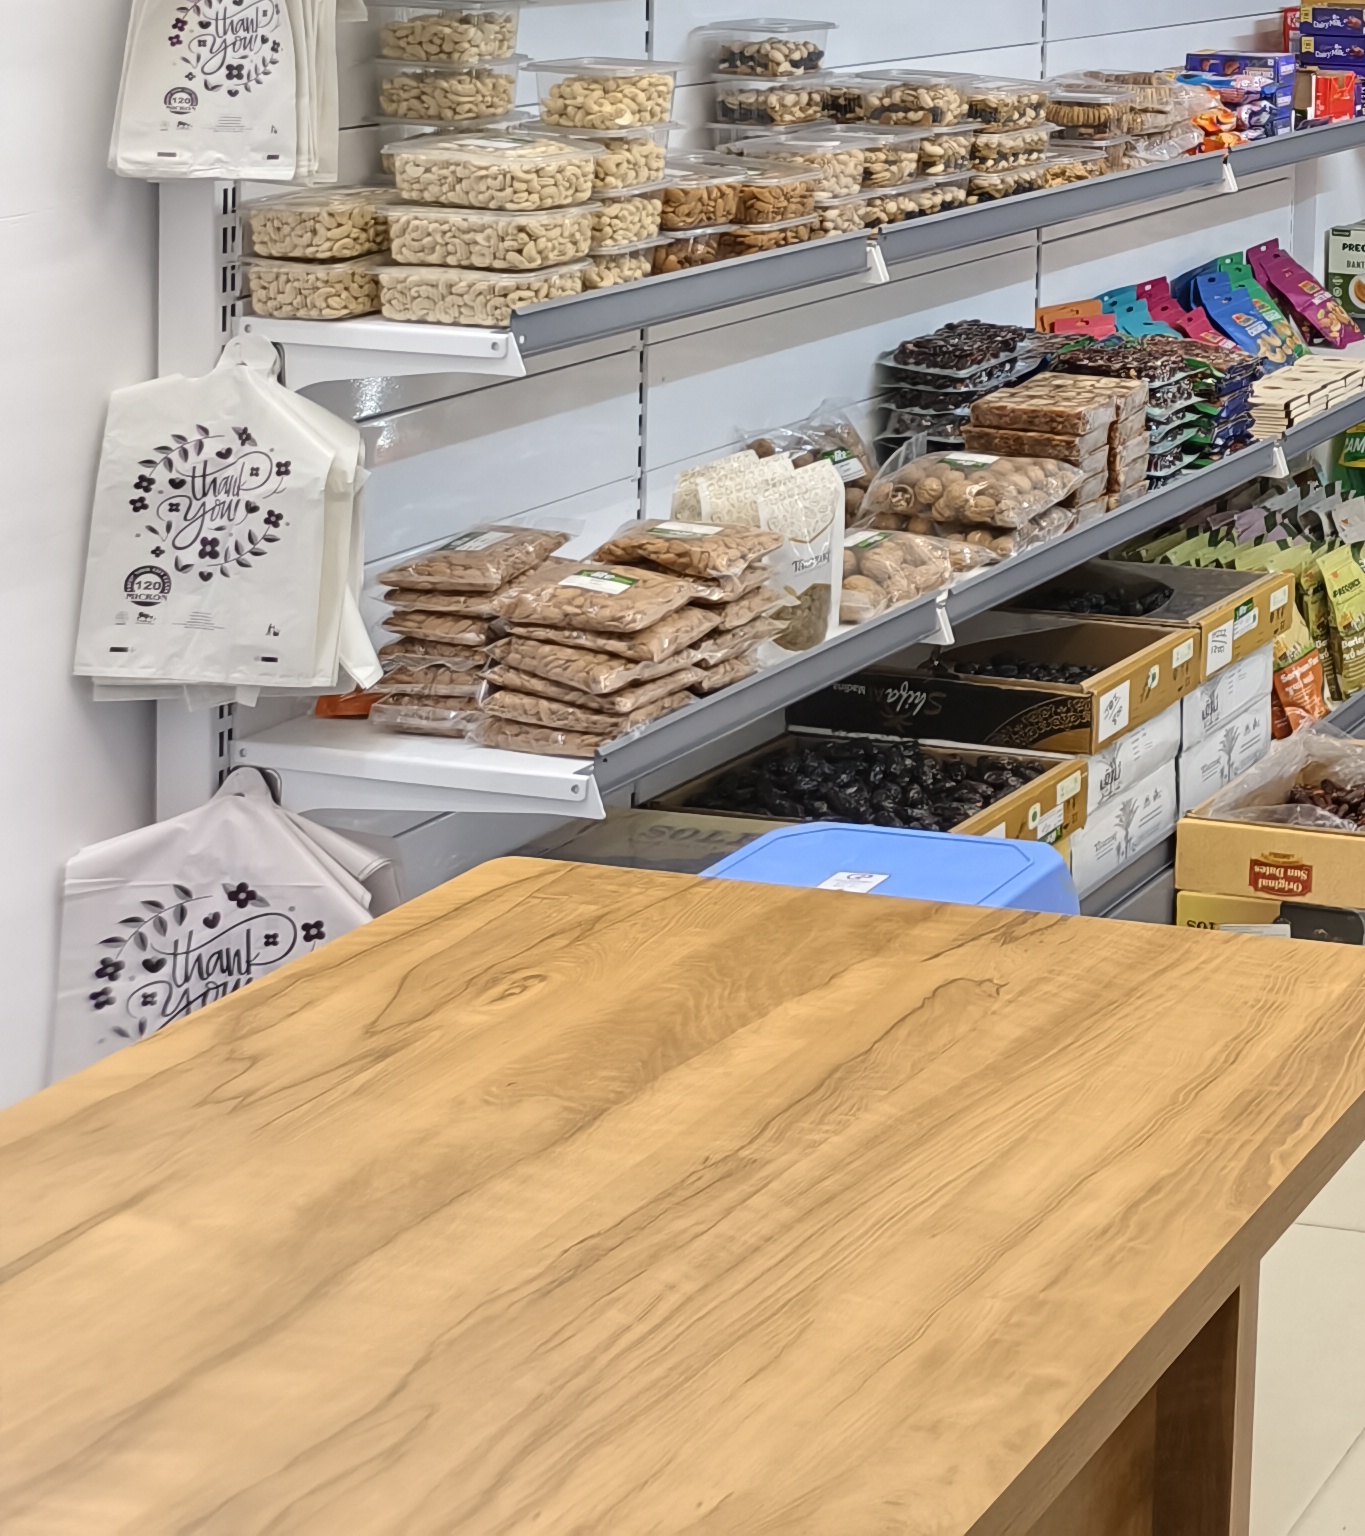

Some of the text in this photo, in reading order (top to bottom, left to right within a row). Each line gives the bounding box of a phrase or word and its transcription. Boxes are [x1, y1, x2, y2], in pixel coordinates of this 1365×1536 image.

[188, 33, 264, 76] you
[171, 96, 191, 105] 120
[176, 451, 273, 501] thank
[157, 495, 249, 550] you
[134, 580, 162, 591] 120
[885, 681, 947, 715] Shifa
[1254, 864, 1309, 880] Sun Dates
[1258, 878, 1303, 892] Original
[151, 912, 297, 988] thank
